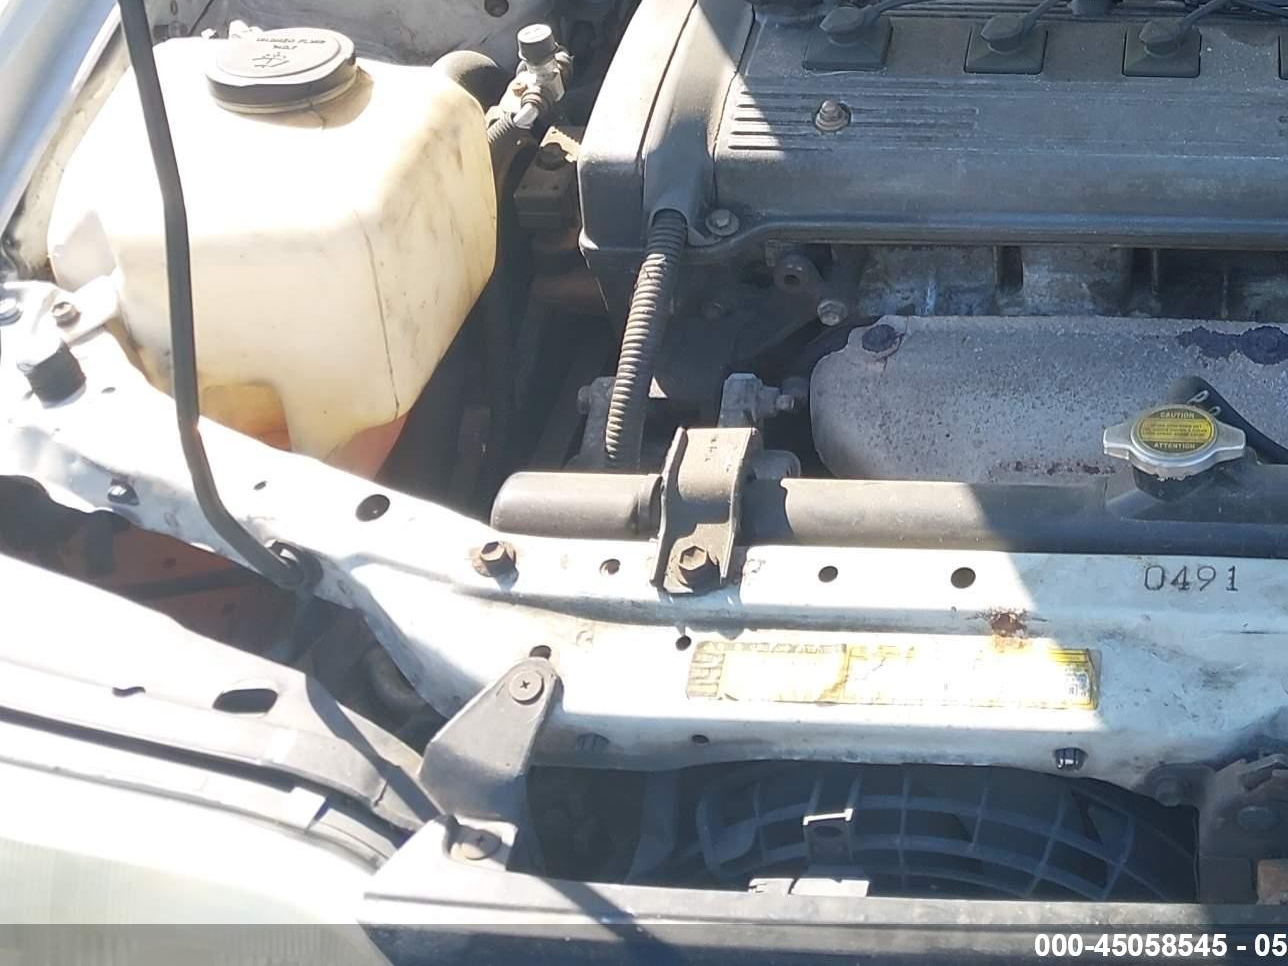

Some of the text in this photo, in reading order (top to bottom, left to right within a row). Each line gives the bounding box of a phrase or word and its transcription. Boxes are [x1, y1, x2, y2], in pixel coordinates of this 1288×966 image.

[1159, 411, 1195, 419] CAUTION
[1153, 442, 1196, 450] ATTENTION
[1144, 565, 1239, 591] 0491
